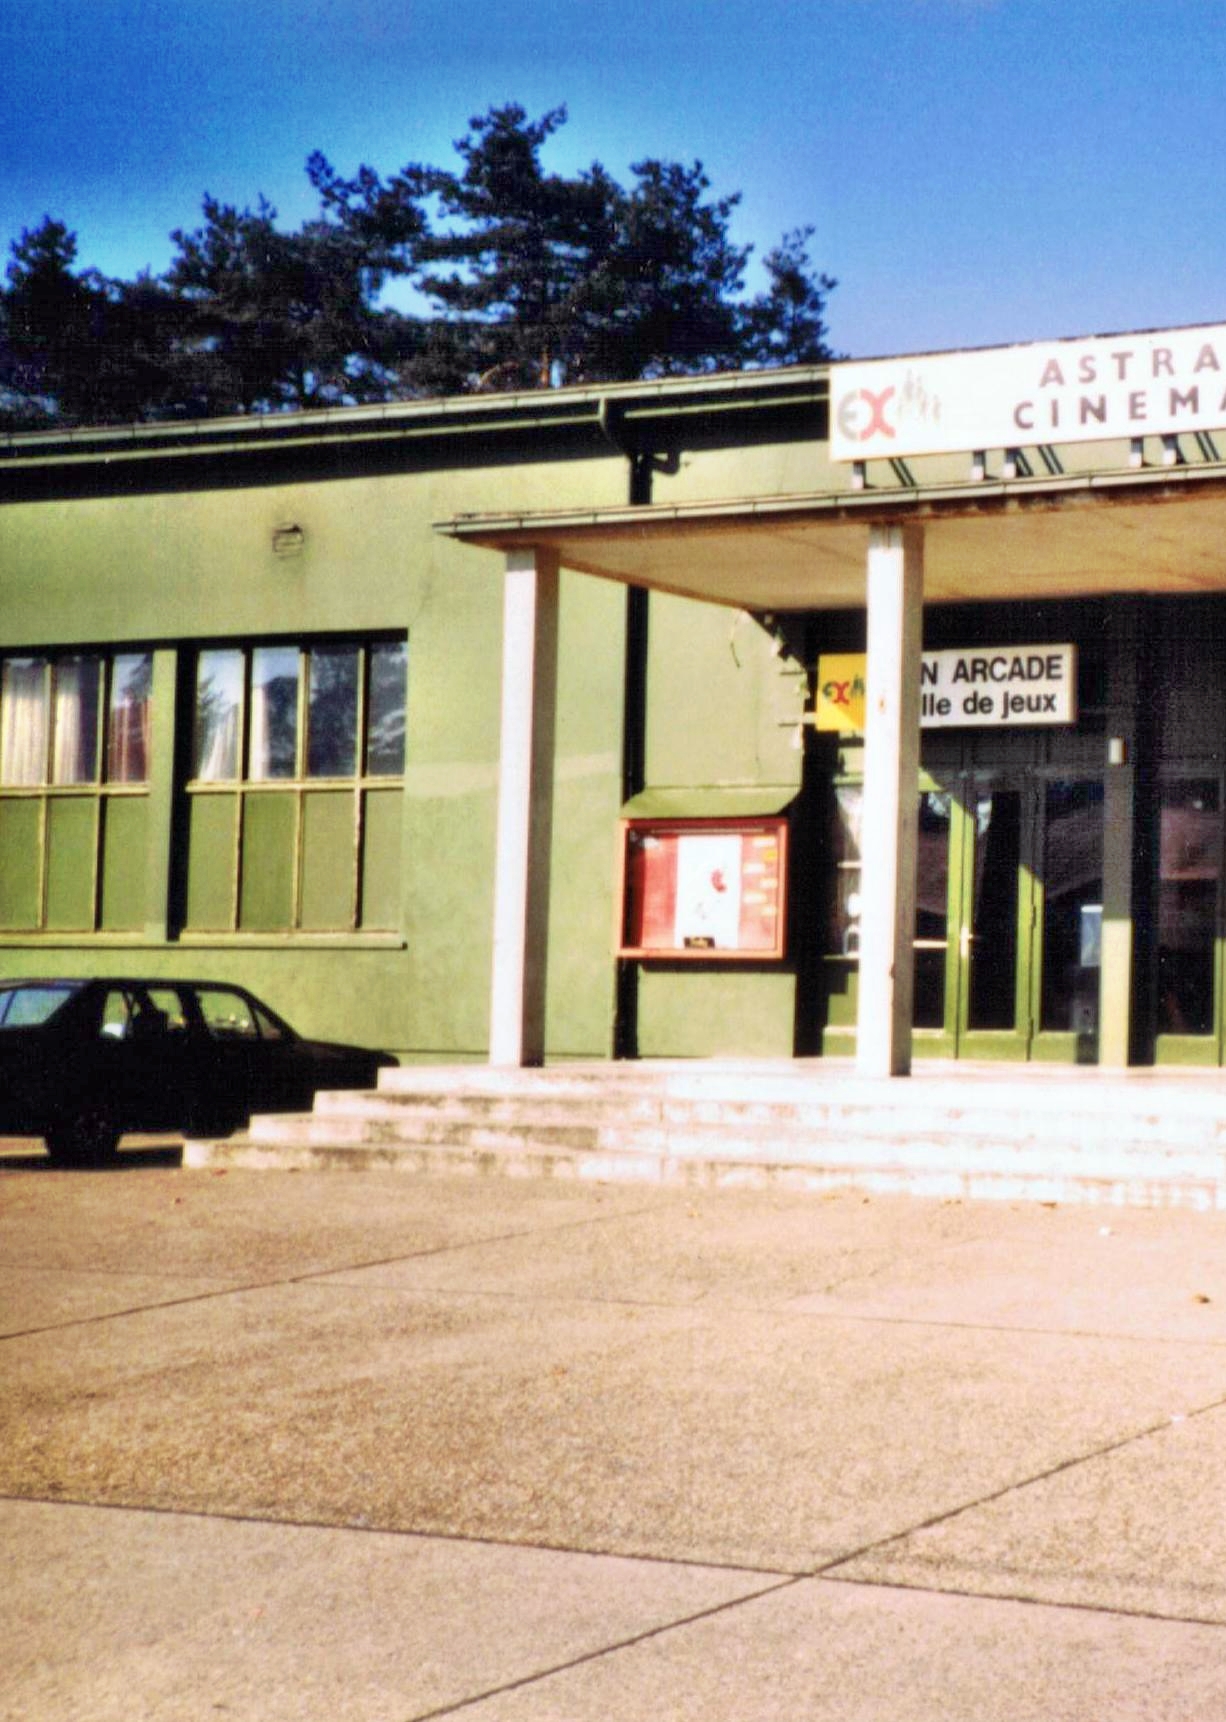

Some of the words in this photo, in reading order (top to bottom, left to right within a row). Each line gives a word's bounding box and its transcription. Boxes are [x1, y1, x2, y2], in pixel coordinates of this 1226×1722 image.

[1039, 343, 1221, 388] ASTRA
[952, 654, 1063, 684] ARCADE
[921, 693, 951, 716] lle
[963, 691, 994, 714] de
[1001, 691, 1057, 719] jeux
